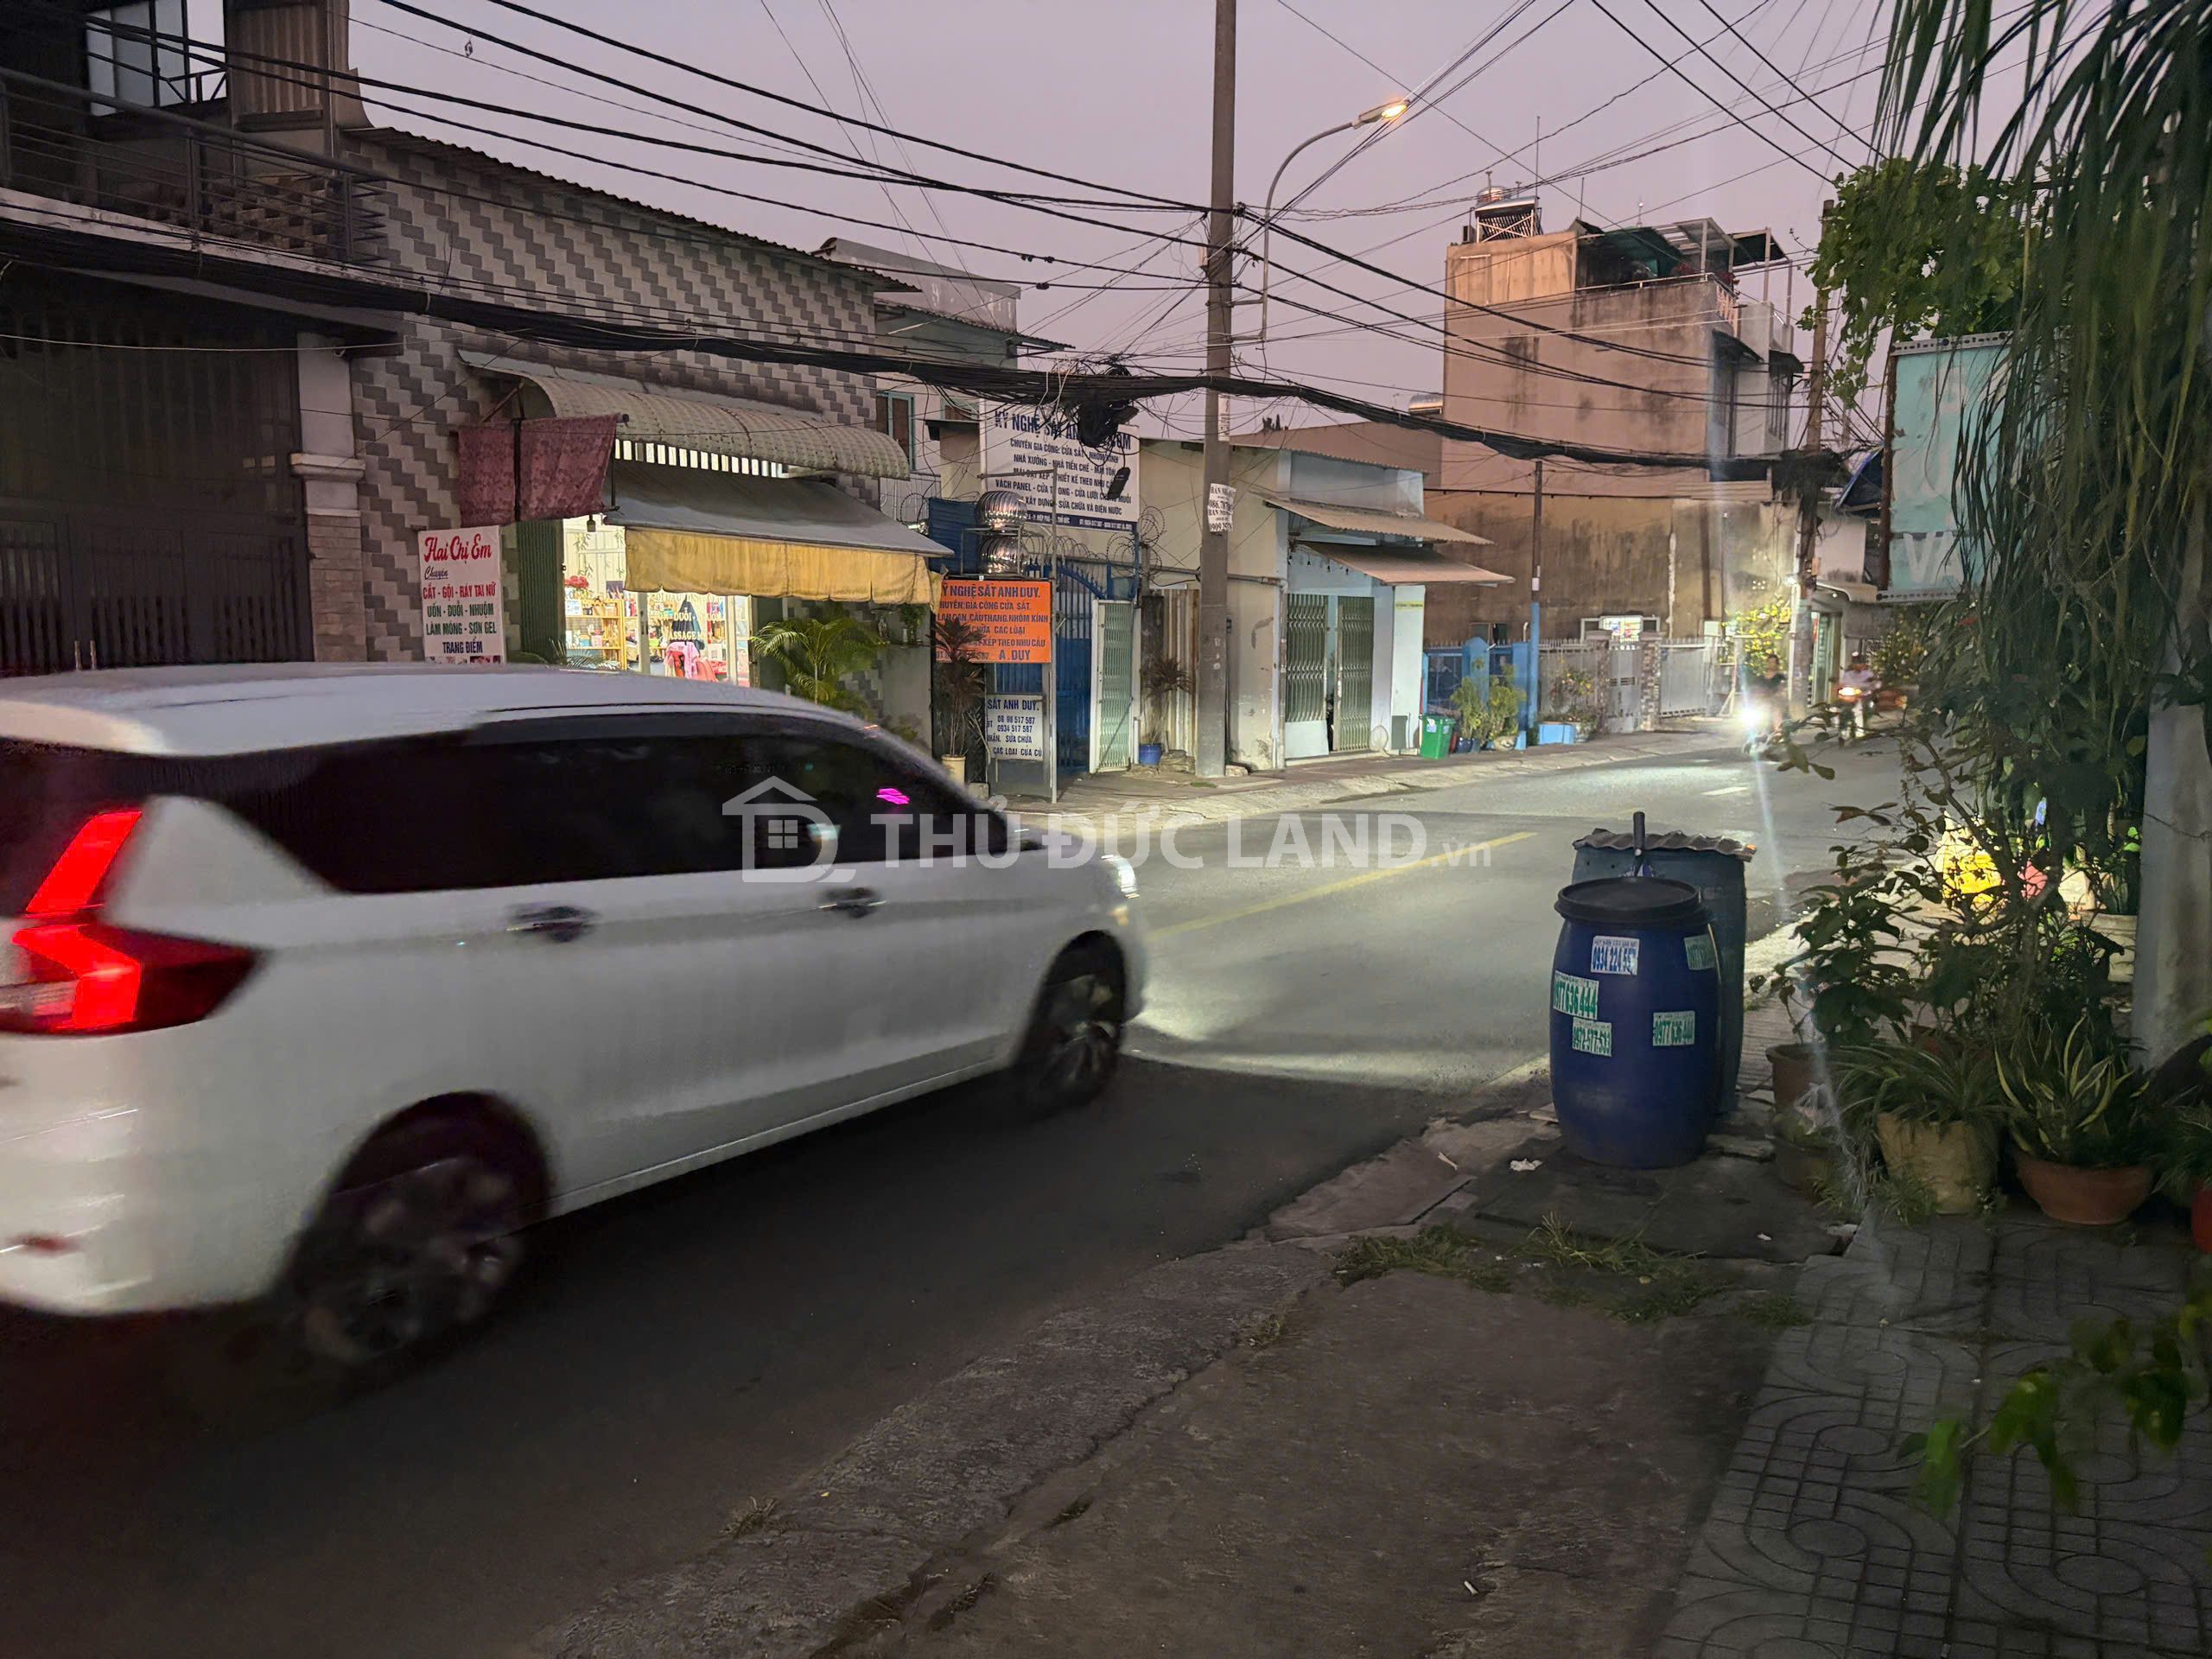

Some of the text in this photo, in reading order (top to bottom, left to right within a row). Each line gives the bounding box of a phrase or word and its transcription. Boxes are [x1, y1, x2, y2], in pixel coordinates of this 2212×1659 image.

[1033, 442, 1044, 452] GIA
[1013, 480, 1032, 492] PANEL
[424, 533, 493, 563] Hai Chị Em
[424, 566, 448, 580] Chuyên
[423, 584, 436, 600] CẮT
[442, 583, 454, 601] GỘI
[474, 584, 485, 598] TAI
[950, 583, 976, 599] NGHỆ
[978, 582, 996, 597] SẮT
[998, 587, 1019, 598] ANH
[470, 603, 494, 619] NHUỘM
[965, 601, 978, 610] GIA
[979, 600, 998, 610] CÔNG
[485, 620, 497, 634] GEL
[442, 640, 464, 654] TRANG
[1016, 639, 1030, 647] NHU
[1011, 649, 1030, 661] DUY
[1003, 699, 1019, 710] ANH
